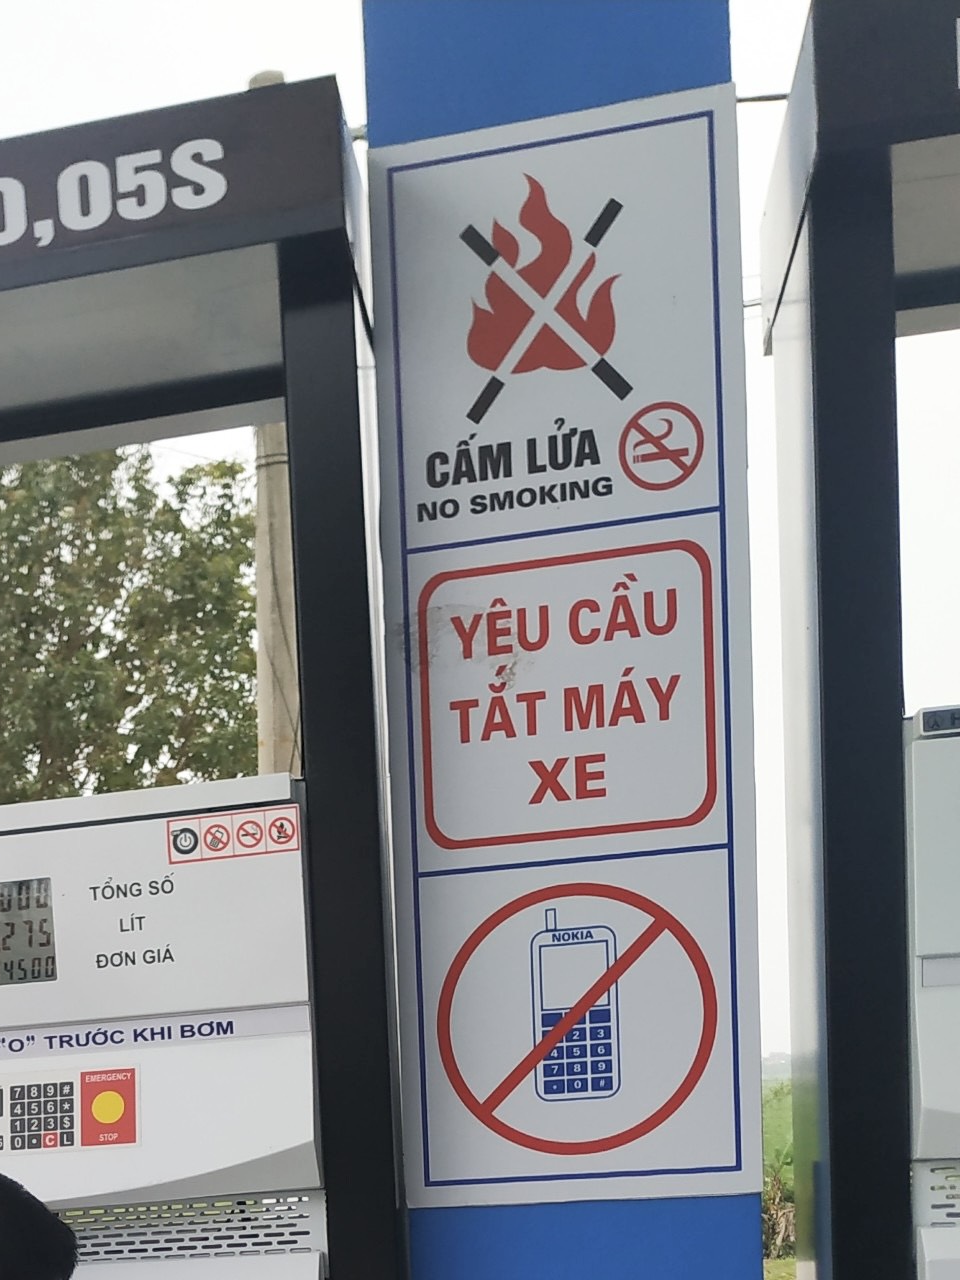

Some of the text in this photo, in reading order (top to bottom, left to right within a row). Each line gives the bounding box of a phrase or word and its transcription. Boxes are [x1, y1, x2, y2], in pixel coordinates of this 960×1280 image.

[426, 418, 600, 488] CẤM LỬA
[417, 476, 613, 522] NO SMOKING
[450, 573, 678, 660] YÊU CẦU
[449, 665, 681, 744] TẮT MÁY
[528, 753, 607, 805] XE
[89, 872, 175, 901] TỔNG SỐ
[119, 913, 146, 932] LÍT
[551, 931, 594, 942] NOKIA
[96, 944, 175, 969] ĐƠN GIÁ
[43, 1028, 125, 1050] TRƯỚC
[133, 1025, 172, 1042] KHI
[180, 1020, 234, 1039] BƠM
[571, 1029, 604, 1040] 2 3
[550, 1045, 605, 1058] 4 5 6
[551, 1062, 605, 1074] 7 8 9
[85, 1073, 132, 1083] EMERGENCY
[574, 1080, 582, 1089] 0
[13, 1085, 70, 1098] 7 8 9 #
[13, 1104, 21, 1114] 4
[31, 1103, 38, 1113] 5
[47, 1102, 54, 1112] 6
[14, 1117, 70, 1131] 1 2 3 $
[14, 1134, 70, 1148] 0 C L
[99, 1133, 118, 1141] STOP
